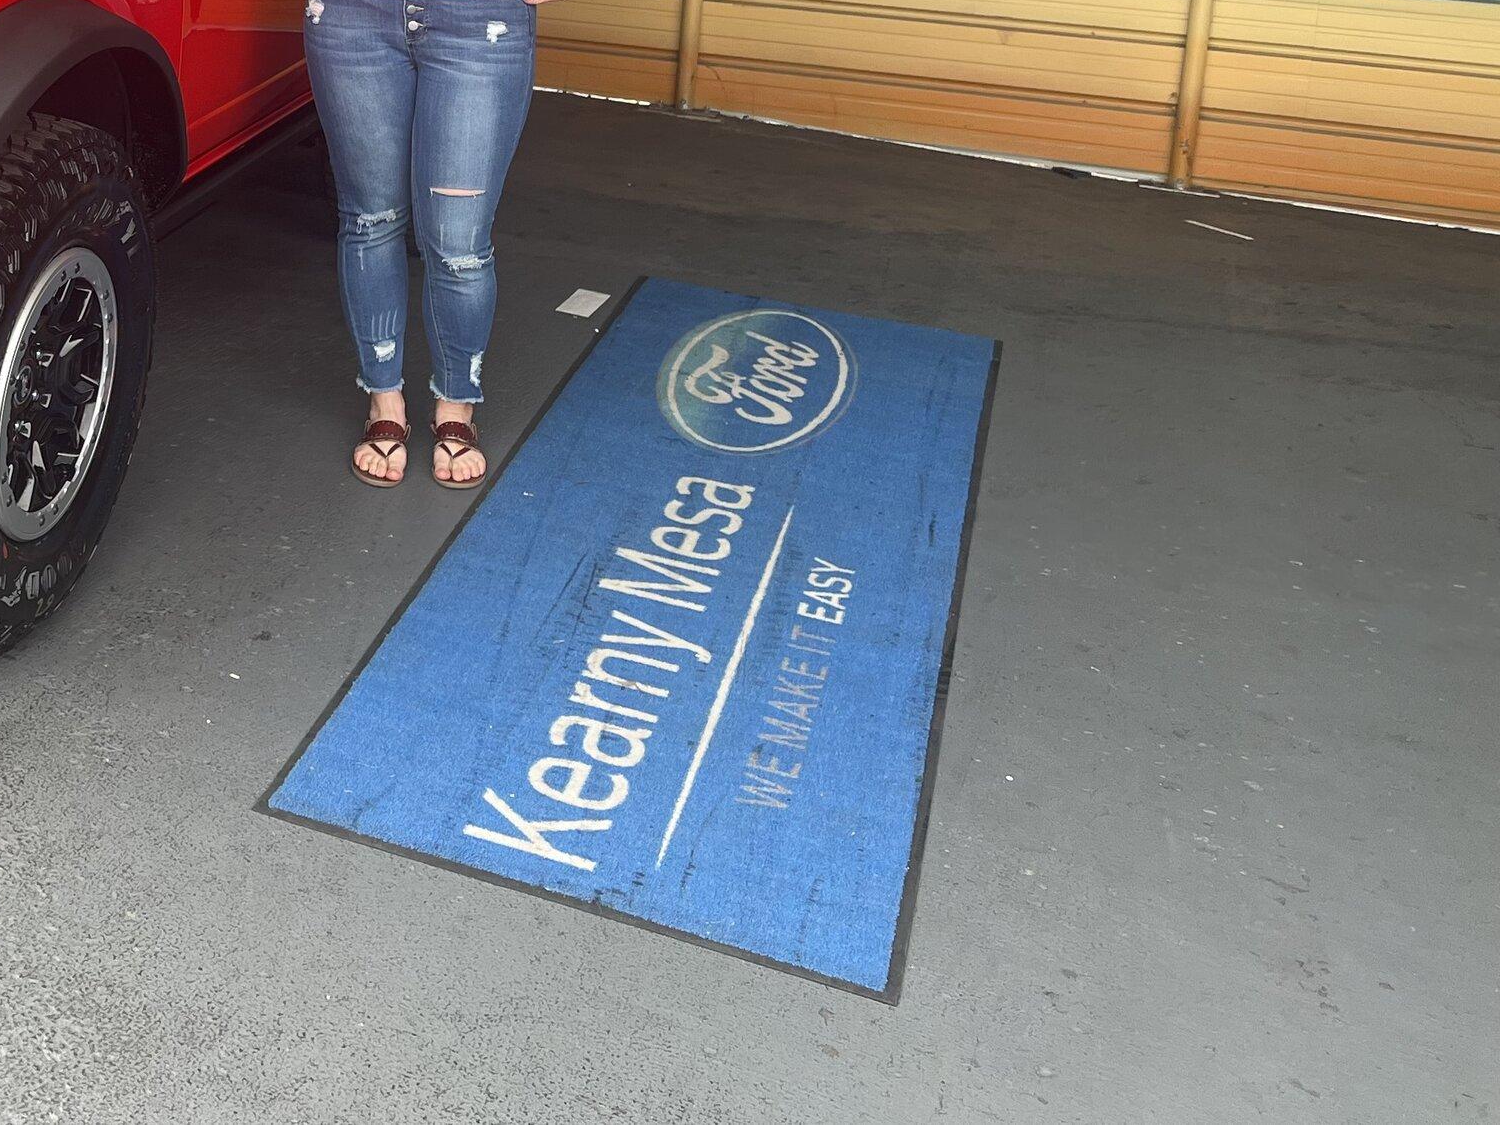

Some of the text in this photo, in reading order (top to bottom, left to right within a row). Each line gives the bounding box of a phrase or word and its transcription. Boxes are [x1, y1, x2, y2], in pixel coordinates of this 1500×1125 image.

[684, 331, 819, 424] Ford
[463, 475, 755, 871] Kearny Mesa
[734, 557, 855, 808] WE MAKE IT EASY
